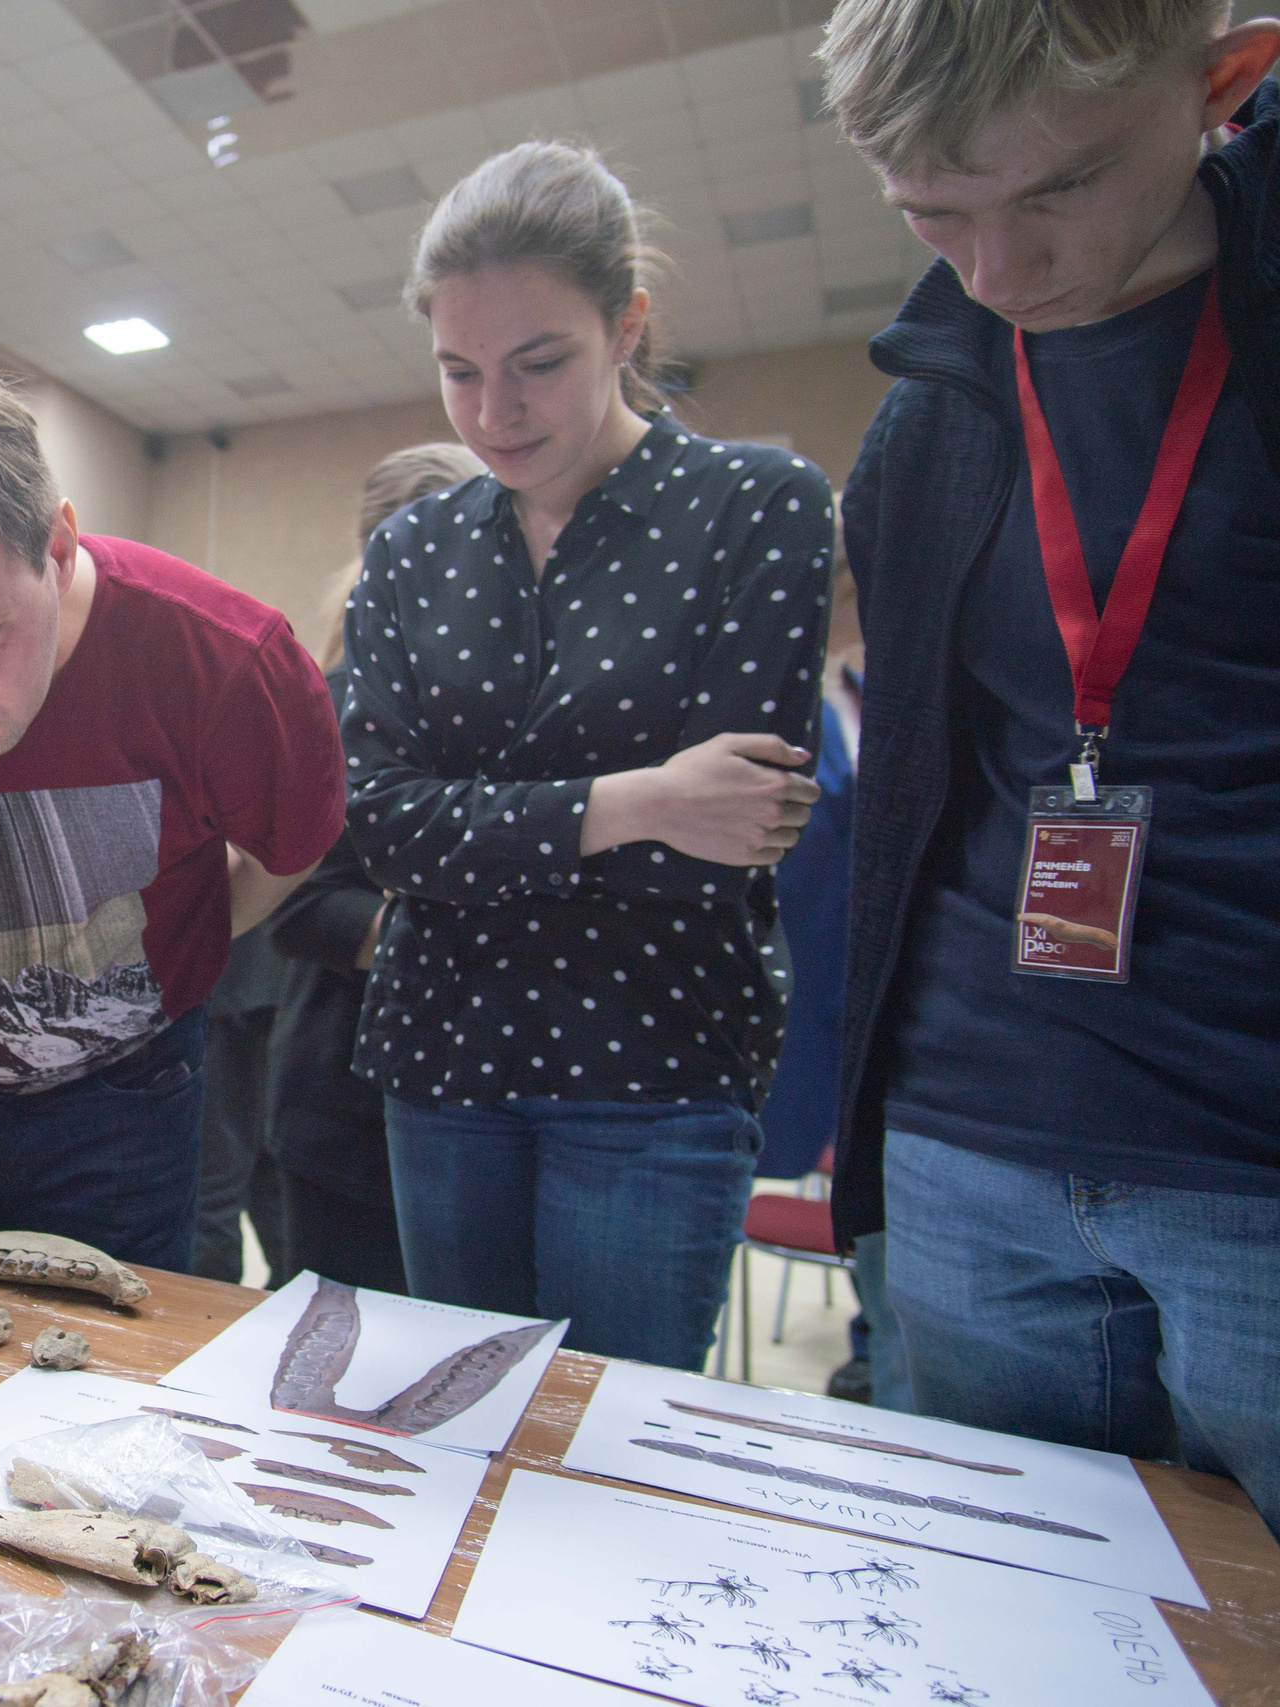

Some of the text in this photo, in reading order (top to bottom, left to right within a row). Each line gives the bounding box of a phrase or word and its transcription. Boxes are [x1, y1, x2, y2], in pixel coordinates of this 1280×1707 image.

[1111, 834, 1130, 842] 2021
[1034, 860, 1091, 872] ЯЧМЕНЁВ
[1033, 872, 1058, 880] ОЛЕГ
[1031, 880, 1079, 889] ЮРЬЕВИЧ
[746, 1486, 931, 1532] ЛОШАДЬ
[728, 1536, 812, 1559] VII-VIII месяц
[1093, 1612, 1168, 1684] ОЛЕНЬ
[322, 1684, 357, 1699] групп
